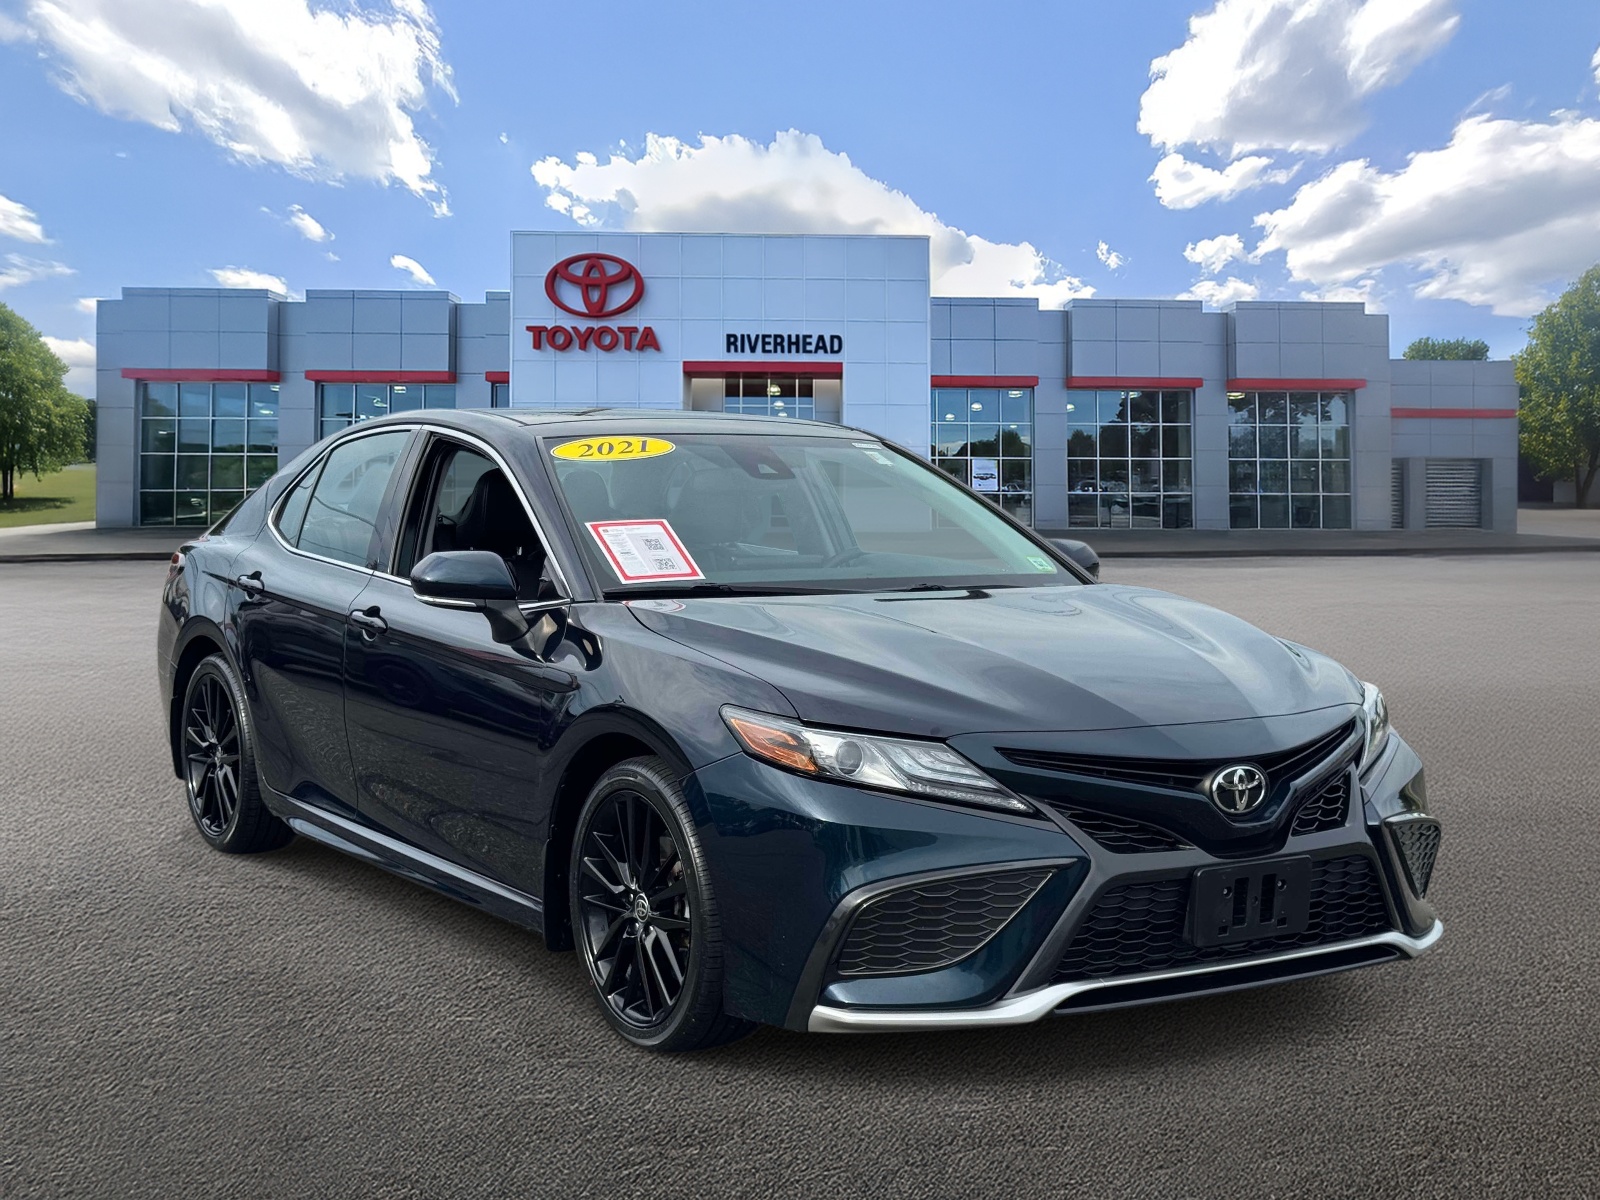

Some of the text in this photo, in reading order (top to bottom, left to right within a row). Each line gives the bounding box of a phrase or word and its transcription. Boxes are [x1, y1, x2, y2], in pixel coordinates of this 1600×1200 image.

[525, 325, 661, 352] TOYOTA
[726, 333, 843, 354] RIVERHEAD
[578, 439, 651, 458] 2021
